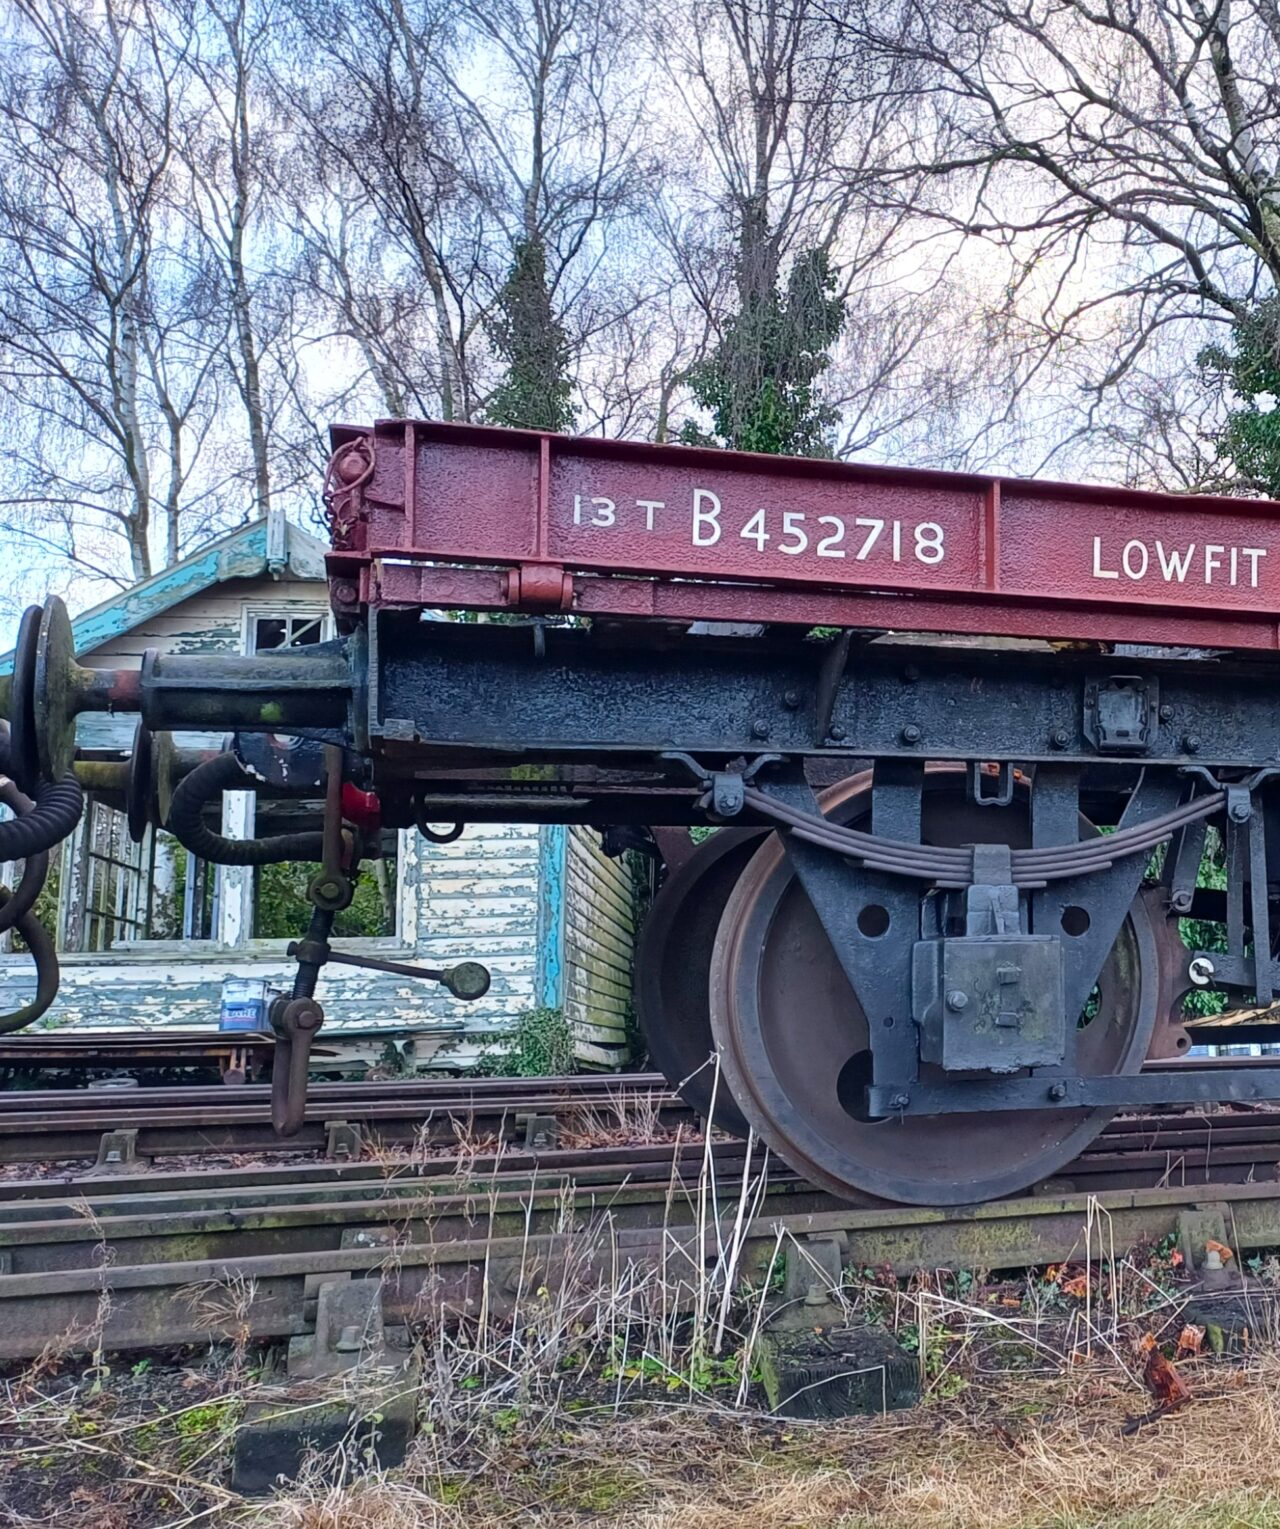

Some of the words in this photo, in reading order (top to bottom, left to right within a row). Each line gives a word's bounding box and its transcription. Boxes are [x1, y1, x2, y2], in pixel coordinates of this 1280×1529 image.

[573, 494, 616, 528] 13
[636, 499, 666, 531] T
[1093, 536, 1268, 588] LOWFIT
